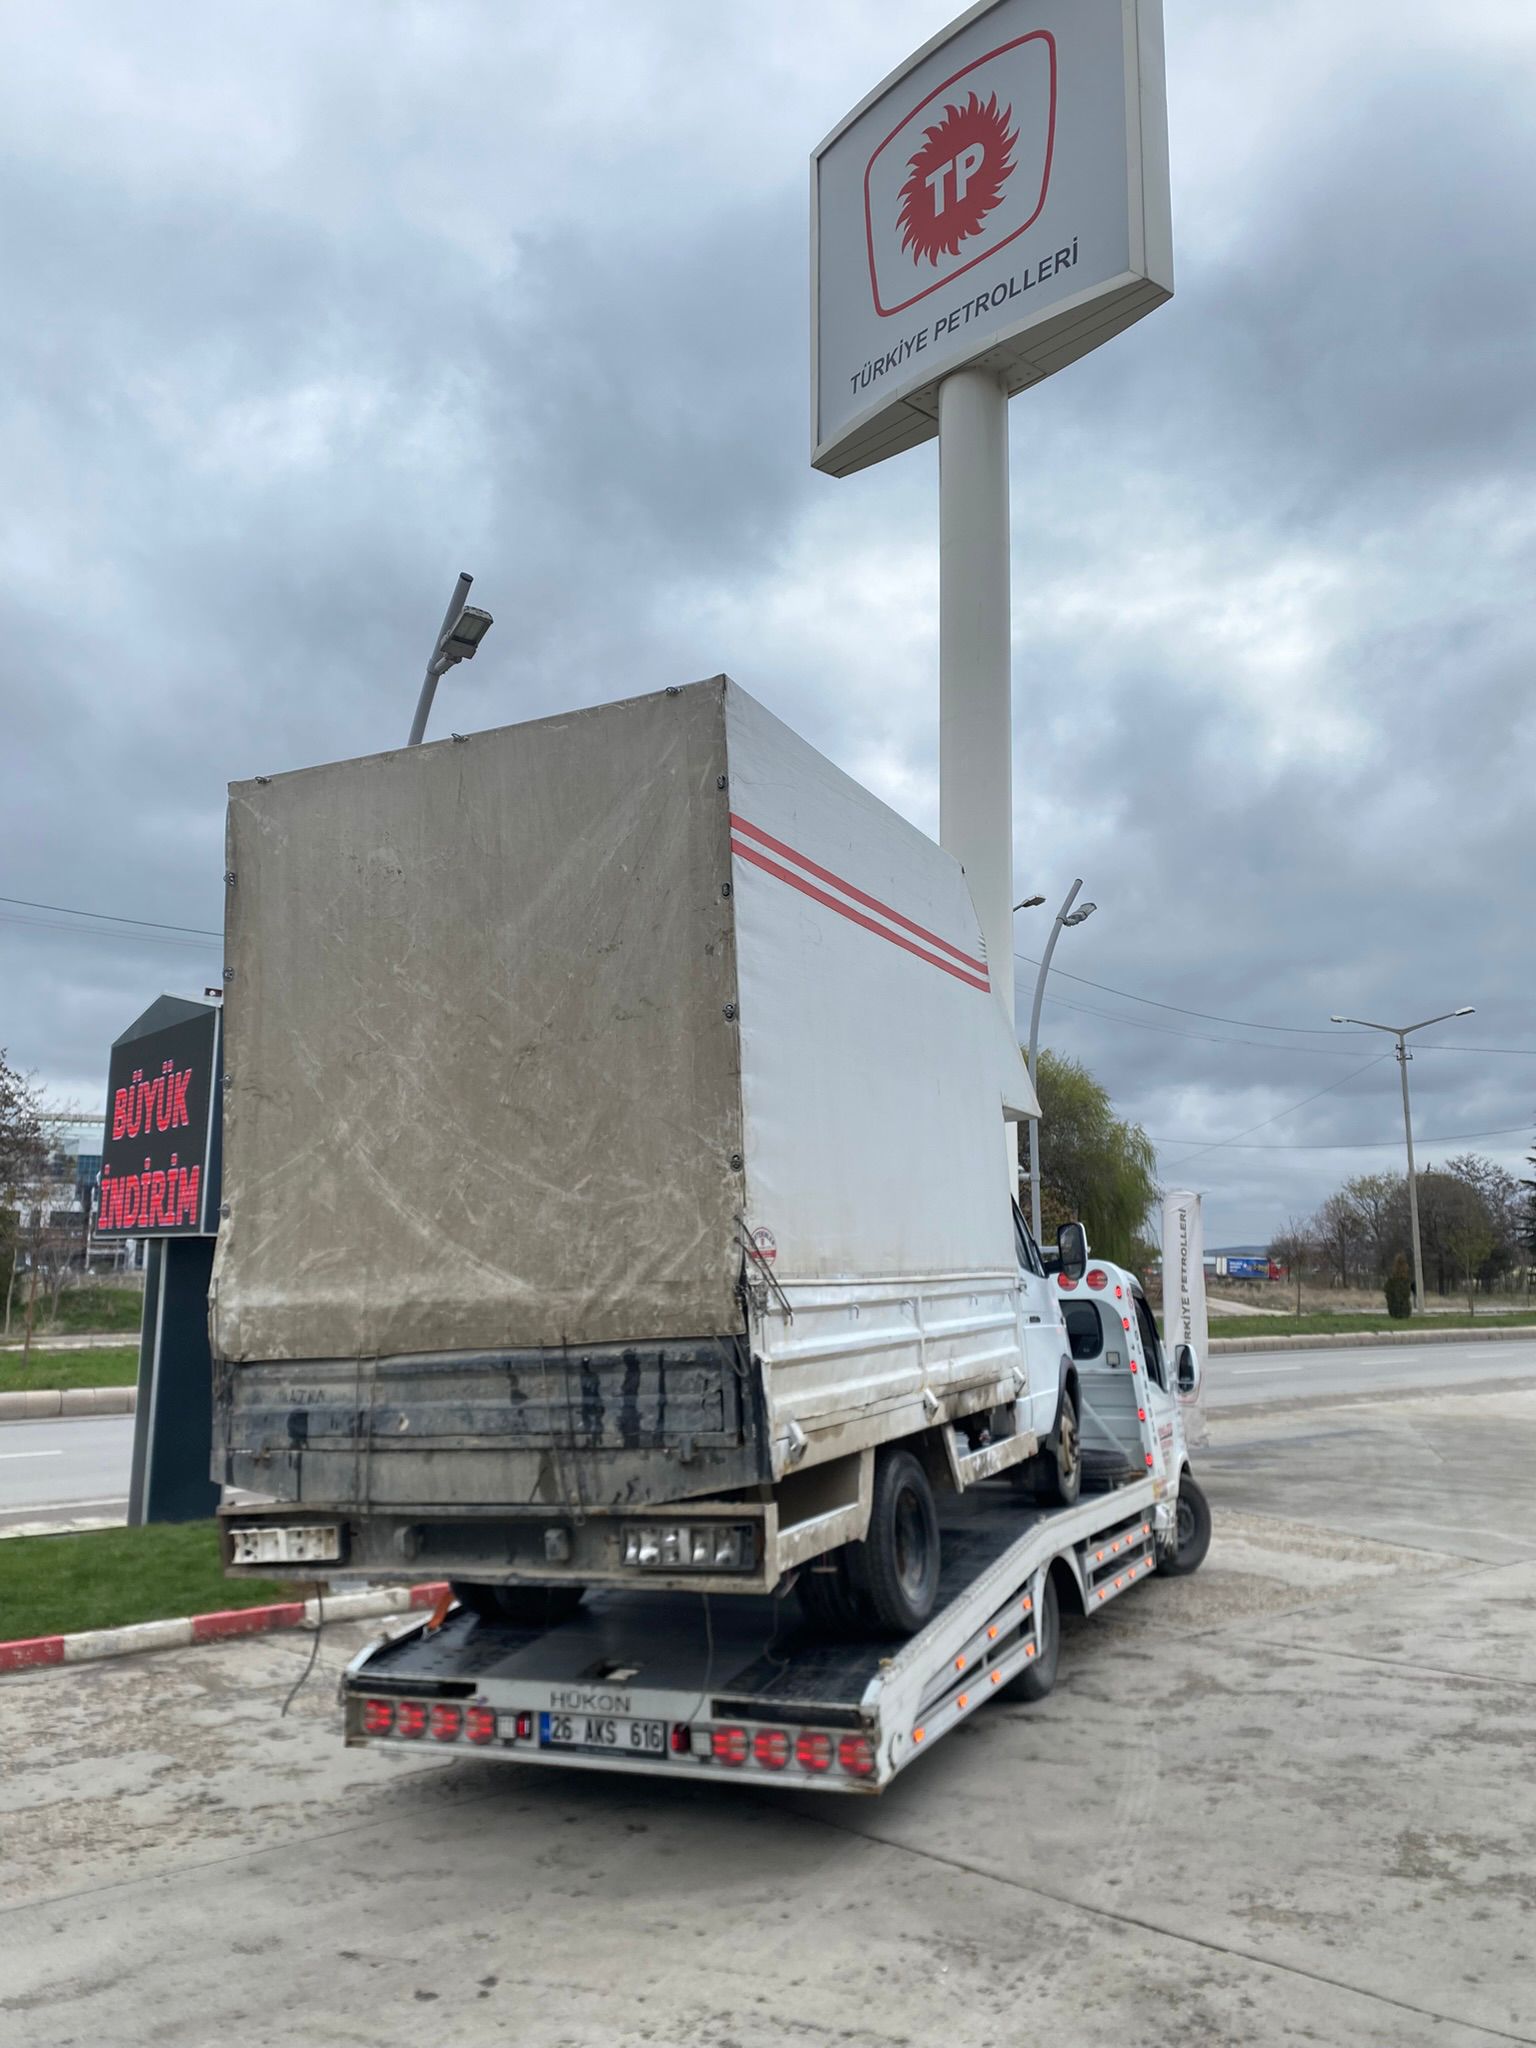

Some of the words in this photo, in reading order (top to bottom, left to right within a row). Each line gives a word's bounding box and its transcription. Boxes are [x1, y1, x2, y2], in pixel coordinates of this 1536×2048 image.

[925, 142, 985, 218] TP
[850, 328, 929, 395] TÜRKİYE
[933, 235, 1079, 342] PETROLLERİ
[112, 1059, 193, 1141] BÜYÜK
[97, 1152, 200, 1230] İNDİRİM
[1178, 1208, 1190, 1293] PETROLLERİ
[1179, 1296, 1192, 1345] RKİYE
[552, 1716, 573, 1741] 26
[584, 1718, 617, 1745] AKS
[630, 1722, 662, 1748] 616
